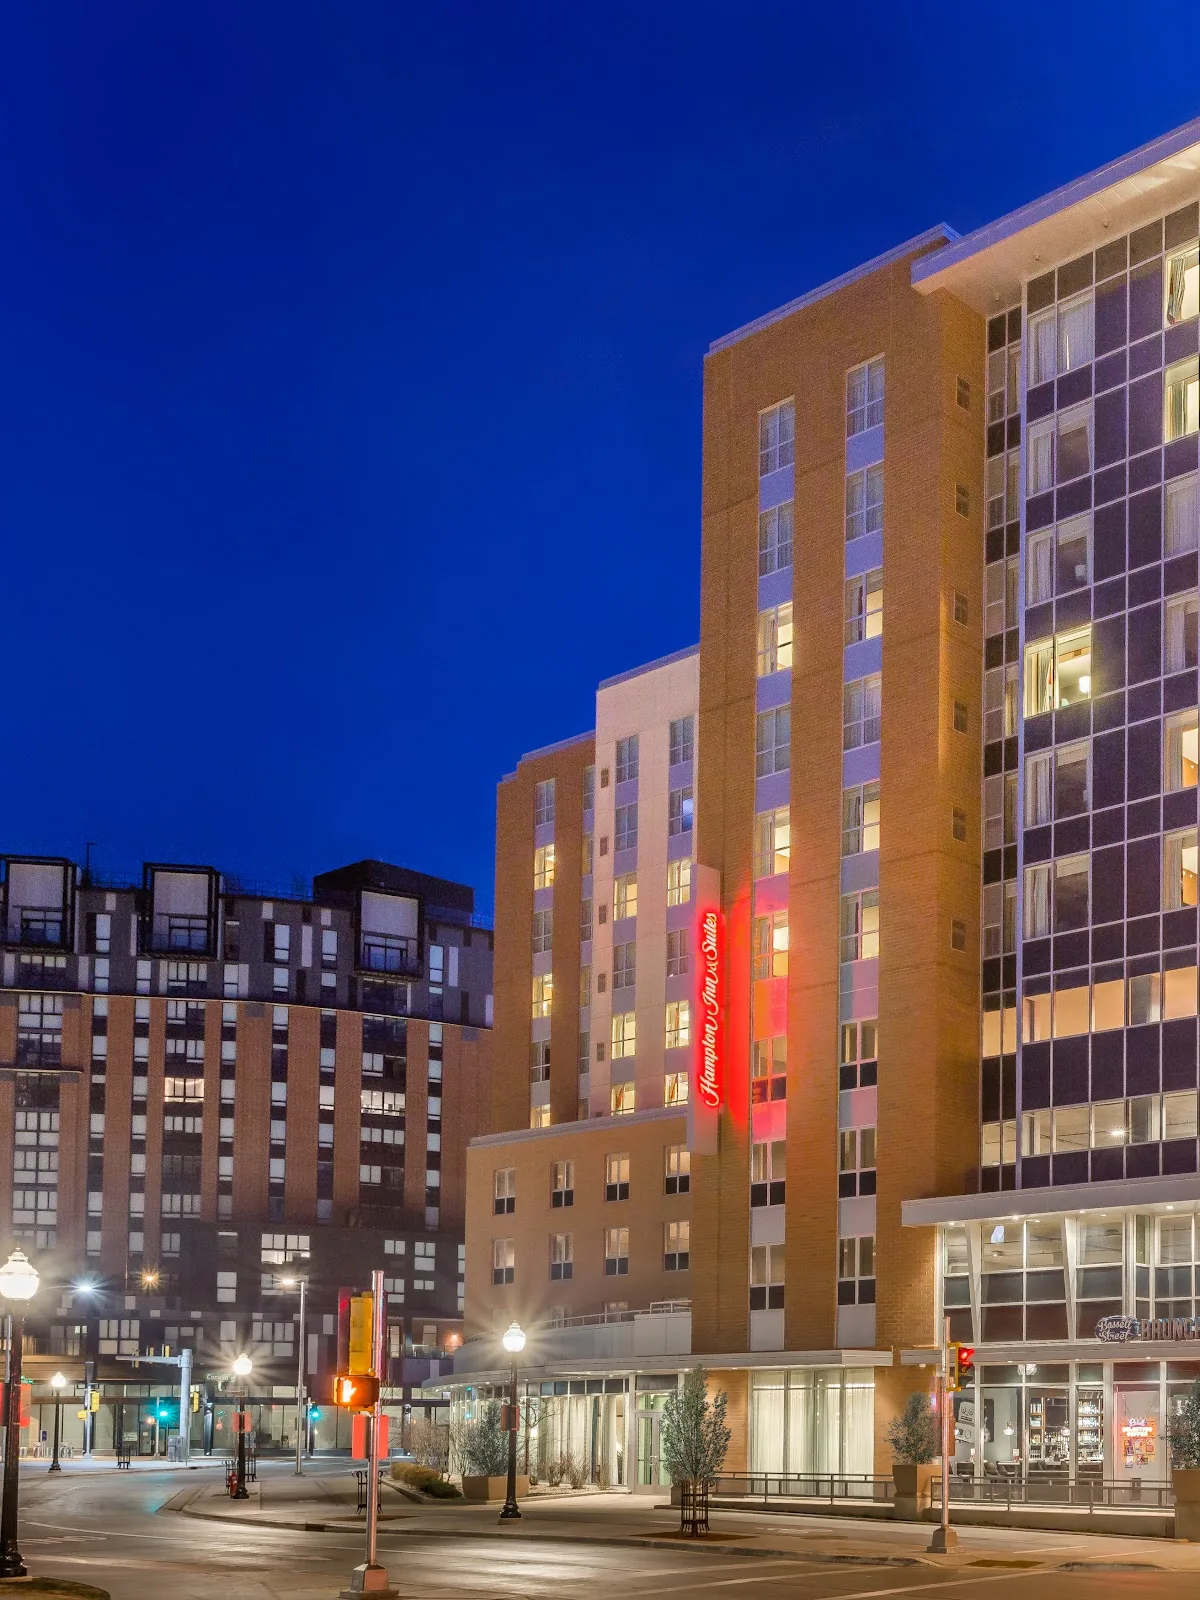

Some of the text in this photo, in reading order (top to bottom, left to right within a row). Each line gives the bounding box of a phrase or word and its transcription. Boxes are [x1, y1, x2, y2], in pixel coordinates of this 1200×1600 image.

[700, 912, 719, 1107] Hampton Inn & Suites
[1098, 1317, 1132, 1331] Bassett
[1099, 1329, 1134, 1343] Street
